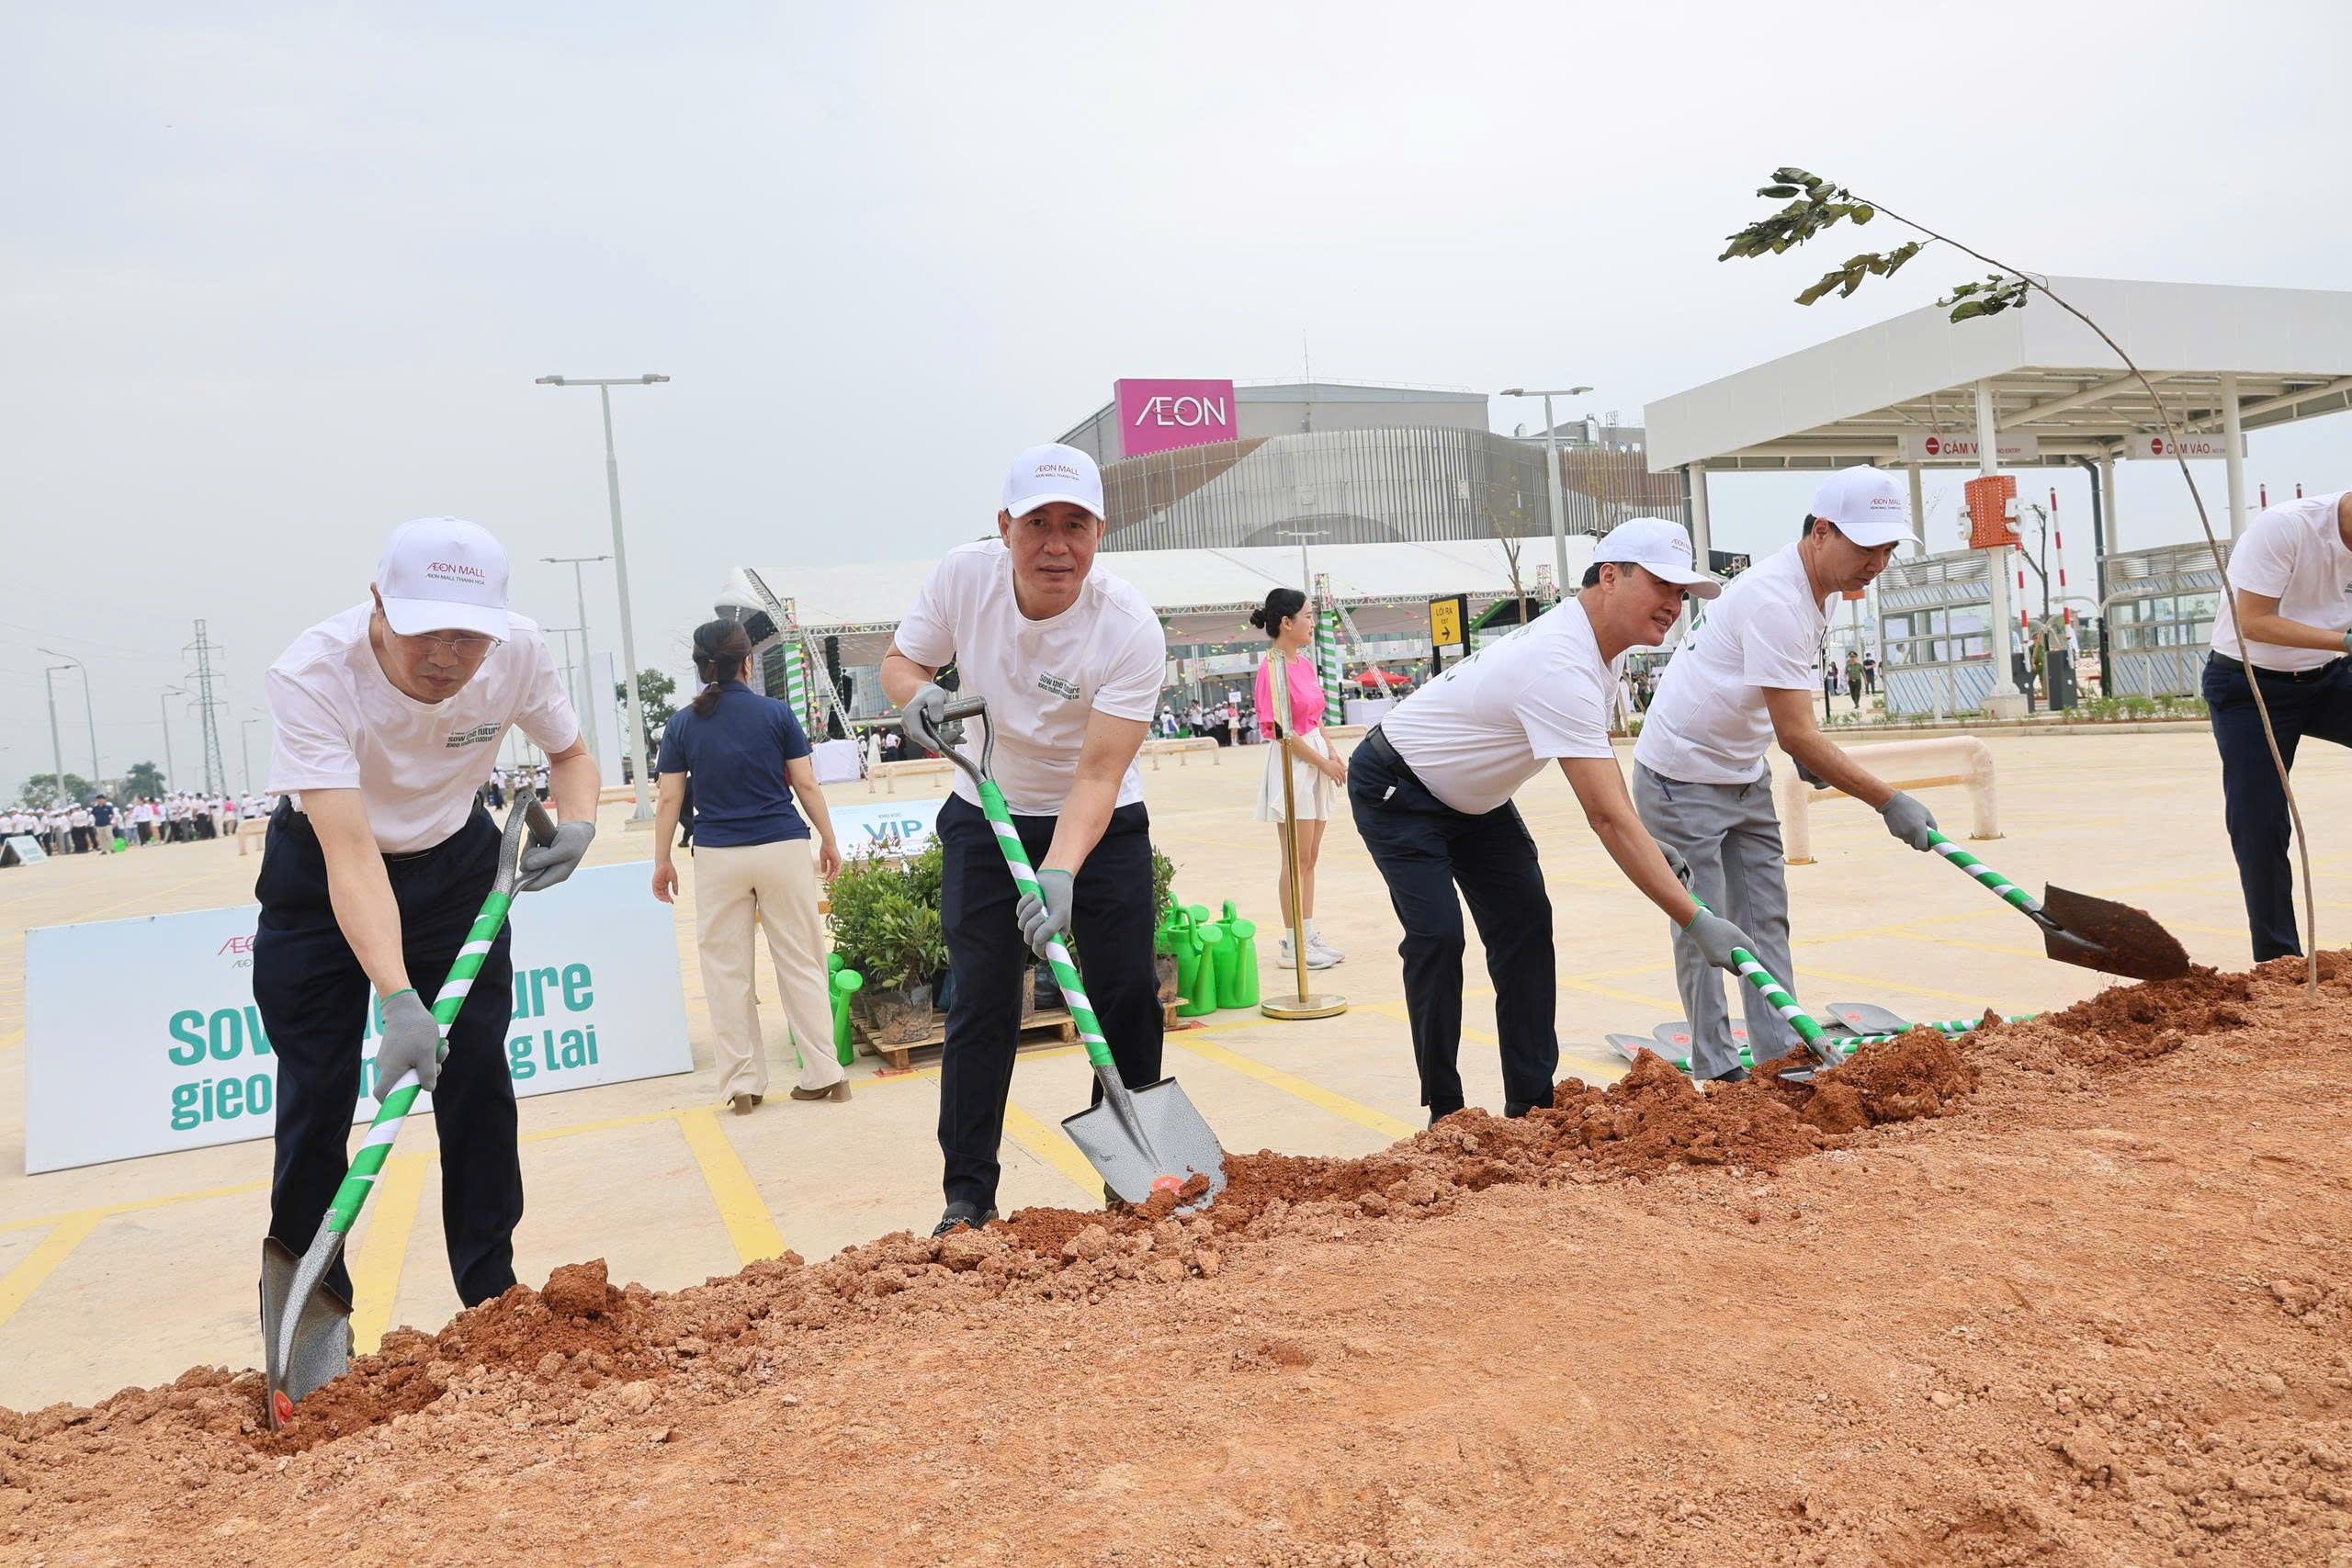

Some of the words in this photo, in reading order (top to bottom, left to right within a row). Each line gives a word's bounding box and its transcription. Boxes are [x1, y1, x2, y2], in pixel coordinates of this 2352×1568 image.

[1057, 464, 1080, 476] MALL
[458, 565, 485, 578] MALL
[862, 819, 923, 841] VIP
[170, 1073, 273, 1131] gieo
[543, 1024, 599, 1072] lai
